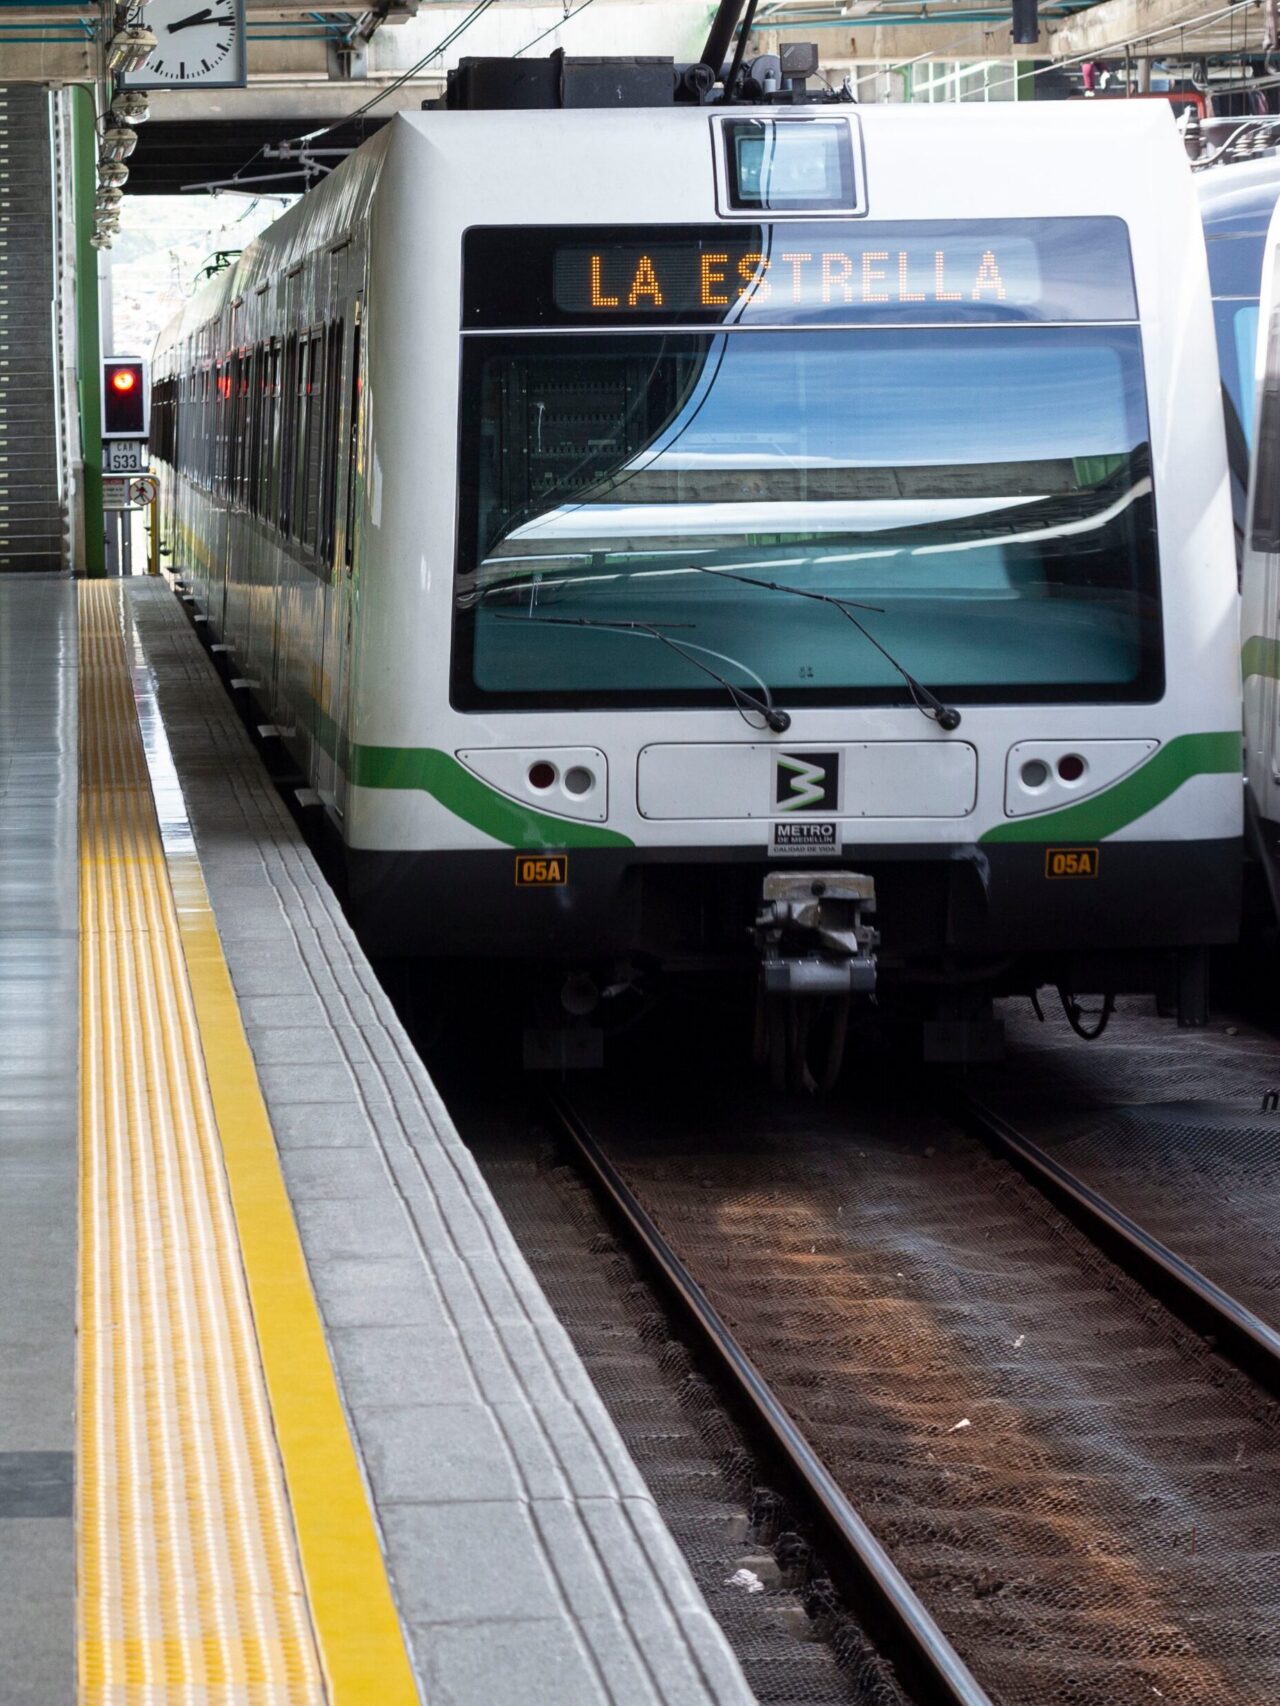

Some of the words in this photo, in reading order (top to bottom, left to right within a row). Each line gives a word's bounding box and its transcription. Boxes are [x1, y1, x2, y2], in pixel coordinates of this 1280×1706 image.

[591, 255, 663, 306] LA
[701, 250, 1007, 304] ESTRELLA
[117, 442, 133, 451] CAR
[113, 455, 137, 469] S33
[777, 824, 833, 836] METRO
[523, 861, 560, 881] 05A
[1053, 854, 1091, 874] 05A
